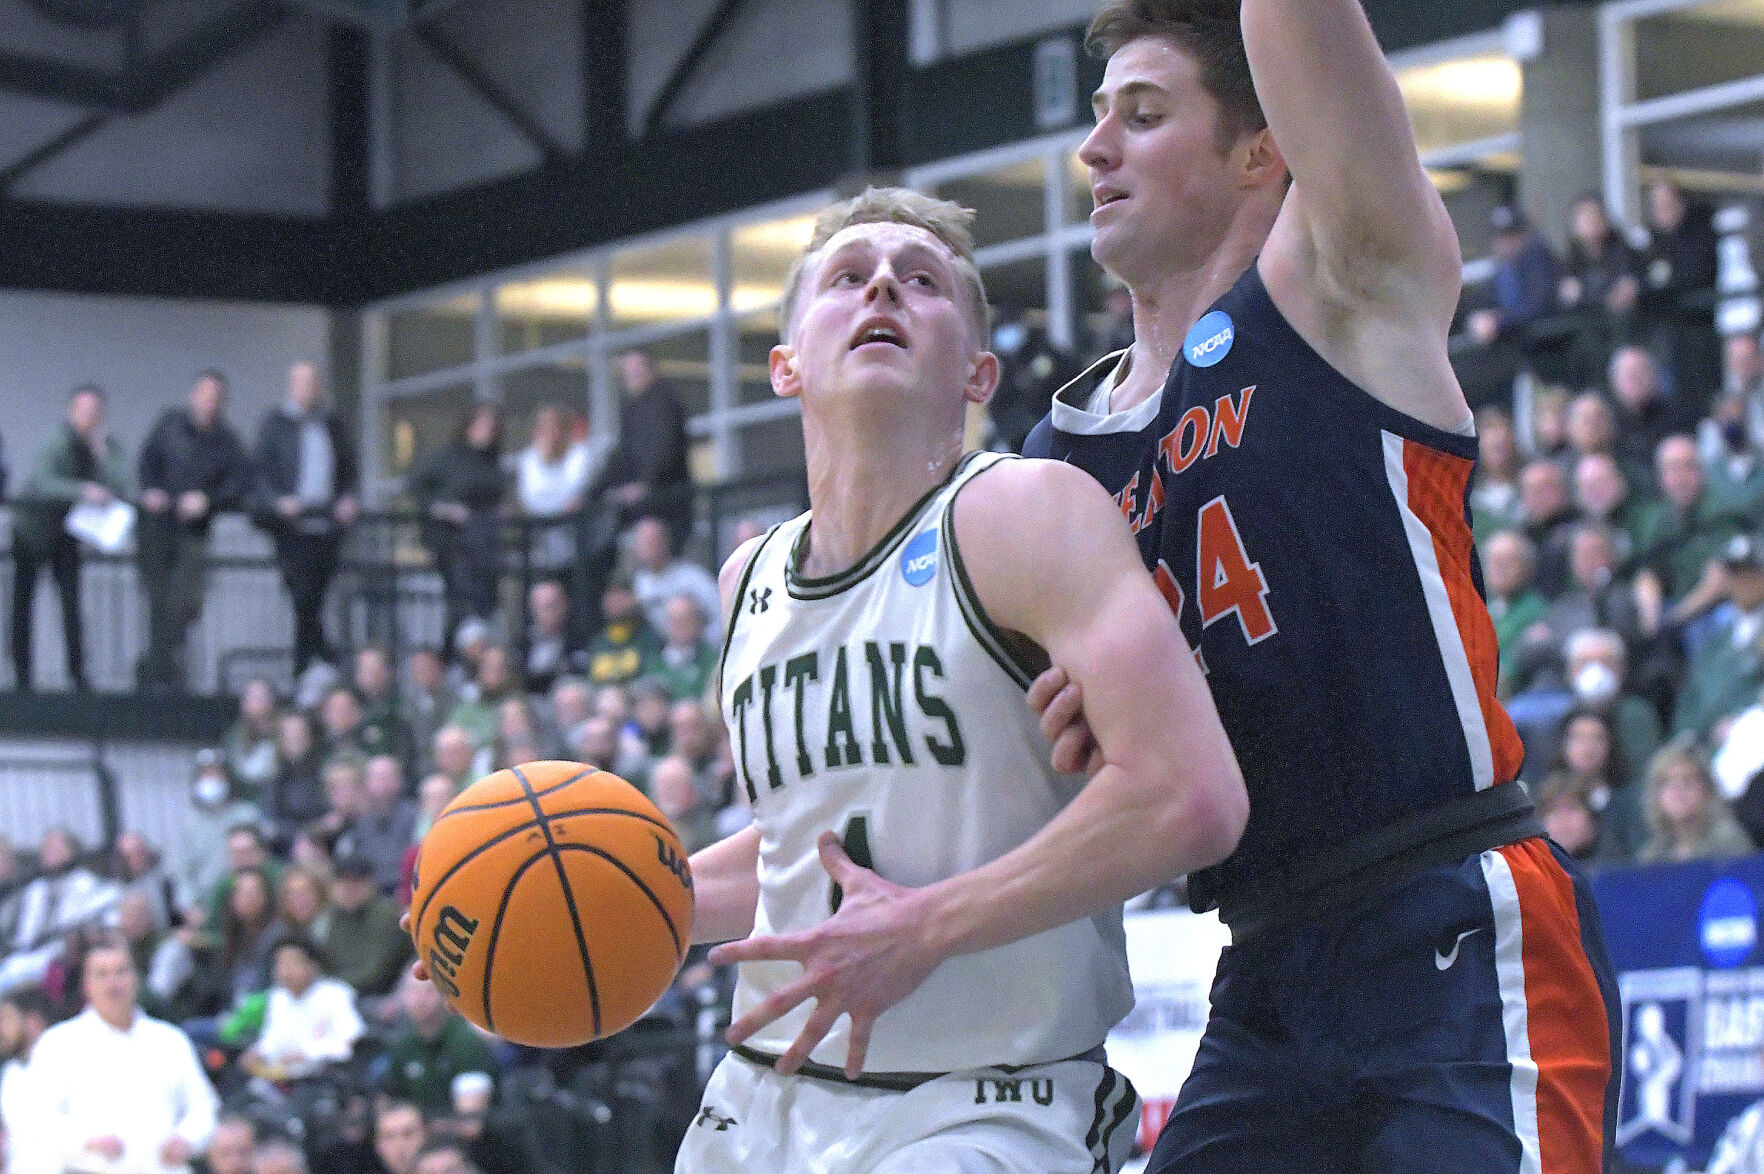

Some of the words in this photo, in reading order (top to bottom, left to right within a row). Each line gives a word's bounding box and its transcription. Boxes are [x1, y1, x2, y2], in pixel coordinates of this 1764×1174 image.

[1192, 327, 1233, 359] NCAA
[733, 642, 966, 803] TITANS
[975, 1079, 1053, 1106] IWU
